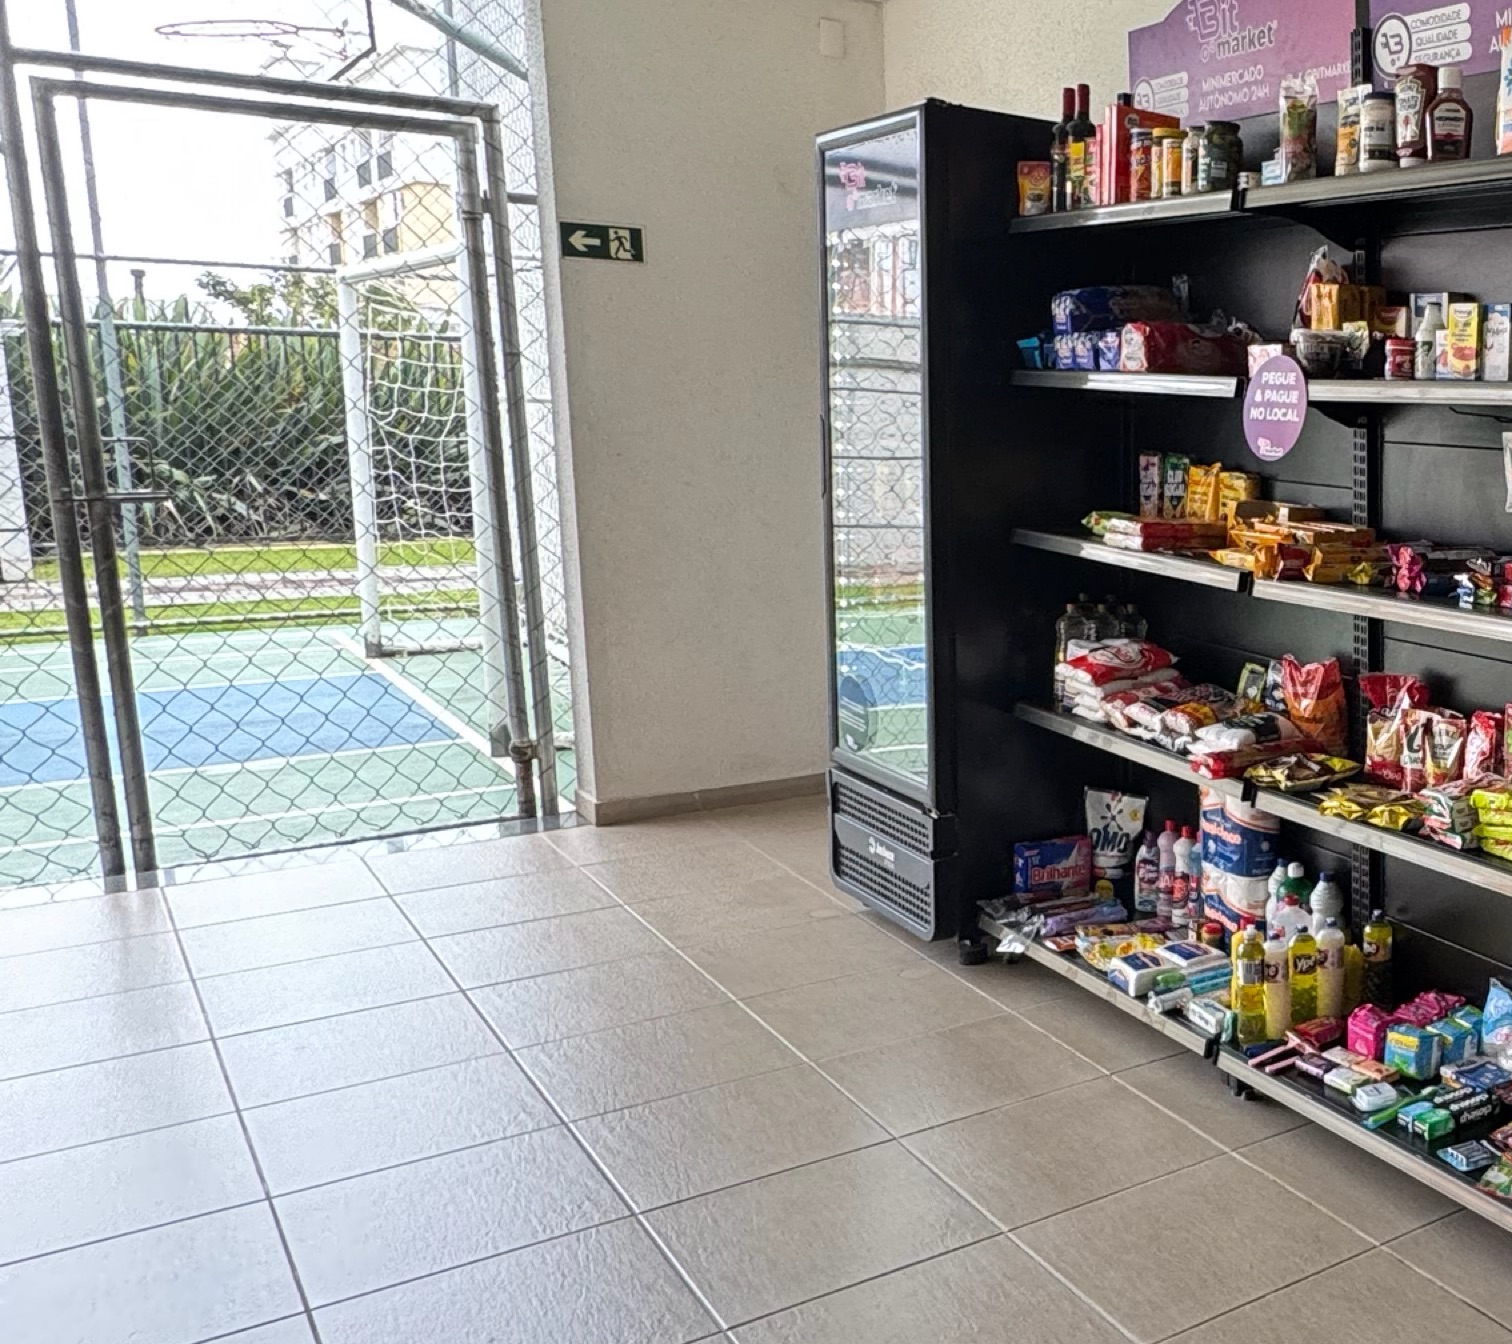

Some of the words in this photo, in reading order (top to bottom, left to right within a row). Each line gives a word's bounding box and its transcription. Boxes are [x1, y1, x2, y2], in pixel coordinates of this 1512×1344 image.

[1410, 9, 1463, 30] COMODIDADE
[1216, 23, 1275, 59] market
[1414, 29, 1460, 48] QUALIDADE
[1202, 64, 1264, 90] MINIMERCADO
[1199, 89, 1248, 113] AUTÔNOMO
[1251, 83, 1270, 103] 24H
[1261, 371, 1297, 386] PEGUE
[1254, 390, 1262, 402] &
[1264, 390, 1299, 404] PAGUE
[1250, 407, 1265, 421] NO
[1266, 407, 1300, 422] LOCAL
[1090, 827, 1130, 853] OMO
[1031, 863, 1087, 885] Brilhante
